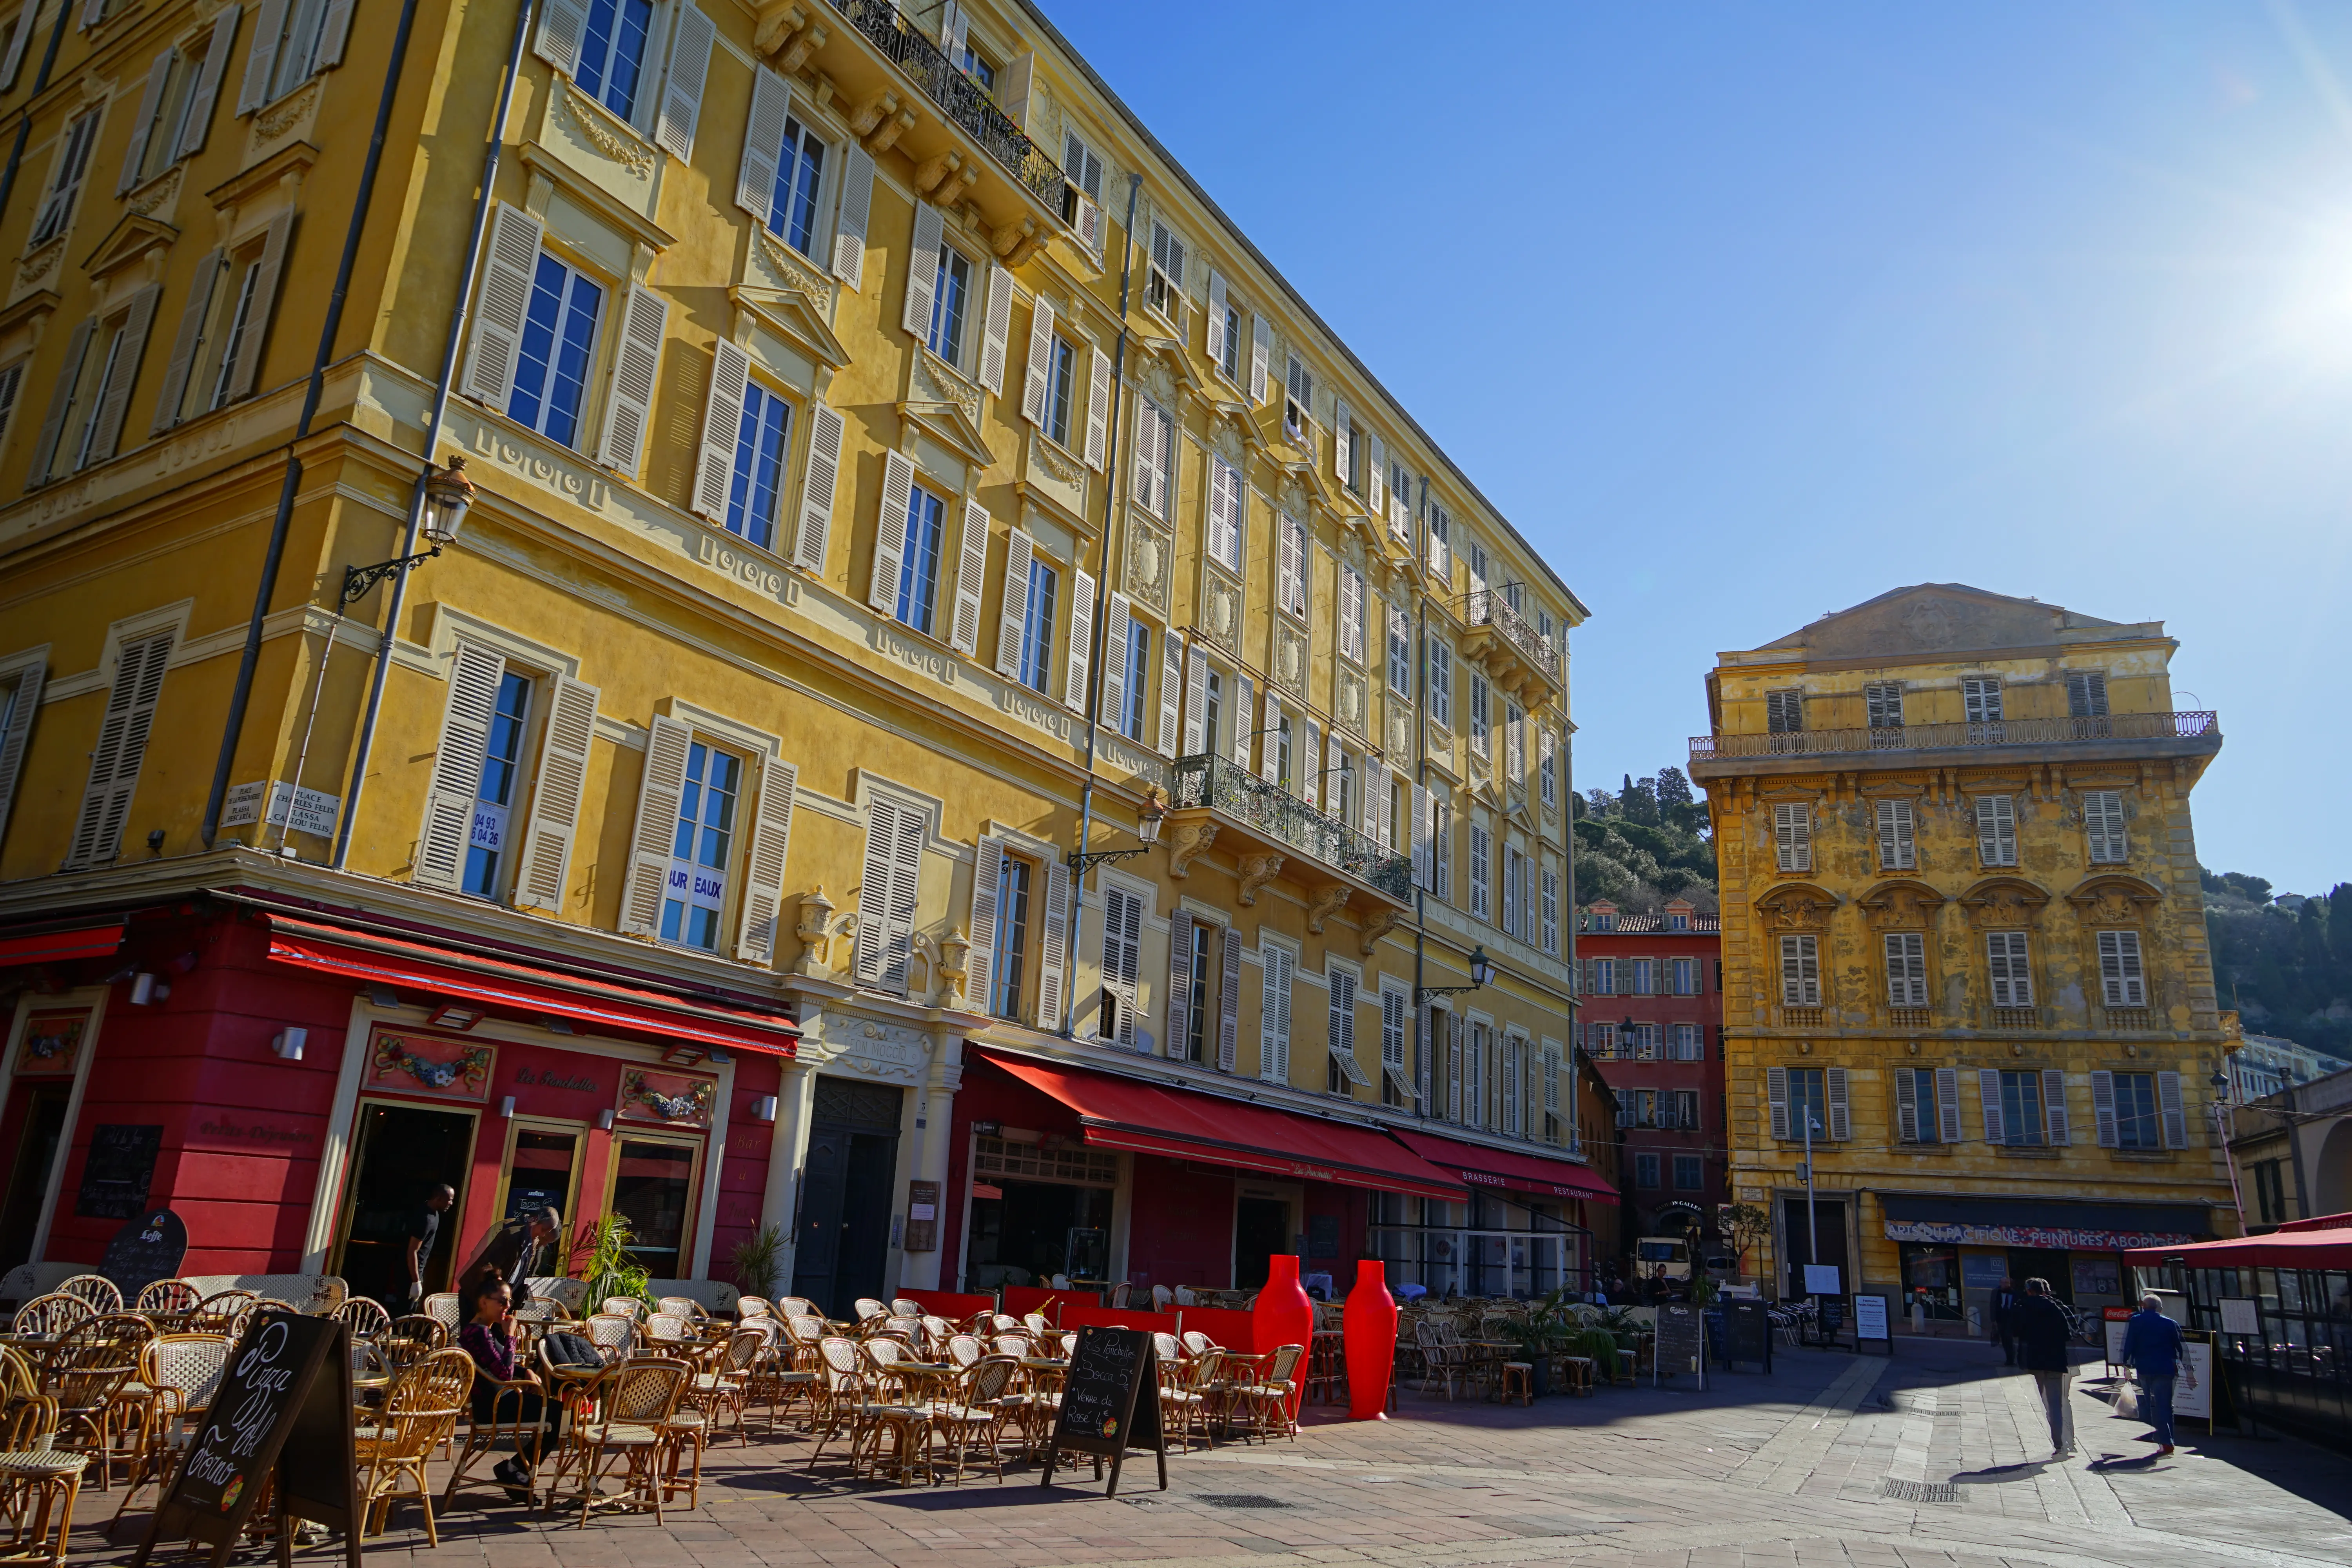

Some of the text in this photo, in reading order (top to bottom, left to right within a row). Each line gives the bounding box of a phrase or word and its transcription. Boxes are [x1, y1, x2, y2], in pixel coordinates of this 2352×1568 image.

[295, 791, 321, 802] PLACE
[291, 809, 319, 822] LASSA
[314, 804, 336, 815] FELIX
[309, 822, 329, 832] FELIS
[475, 814, 495, 830] 04 93
[477, 829, 488, 842] 04
[488, 832, 499, 845] 26
[516, 1067, 598, 1092] Les Ponchettes
[921, 1102, 926, 1111] 3
[734, 1134, 761, 1149] Bar
[1463, 1171, 1593, 1199] BRASSERIE RESTAURANT
[519, 1198, 540, 1212] Tapas
[139, 1230, 163, 1242] Leffe
[1887, 1225, 1919, 1236] ARTS
[1924, 1227, 1942, 1239] DU
[1946, 1227, 2018, 1242] PACIFIQUE
[2032, 1232, 2103, 1247] PEINTURES
[1670, 1306, 1688, 1314] Carlsberg
[1082, 1333, 1136, 1359] Les Ponchettes
[1078, 1361, 1114, 1382] Socca
[1101, 1394, 1114, 1406] de
[1067, 1405, 1092, 1423] Rosé
[187, 1425, 239, 1486] Forno
